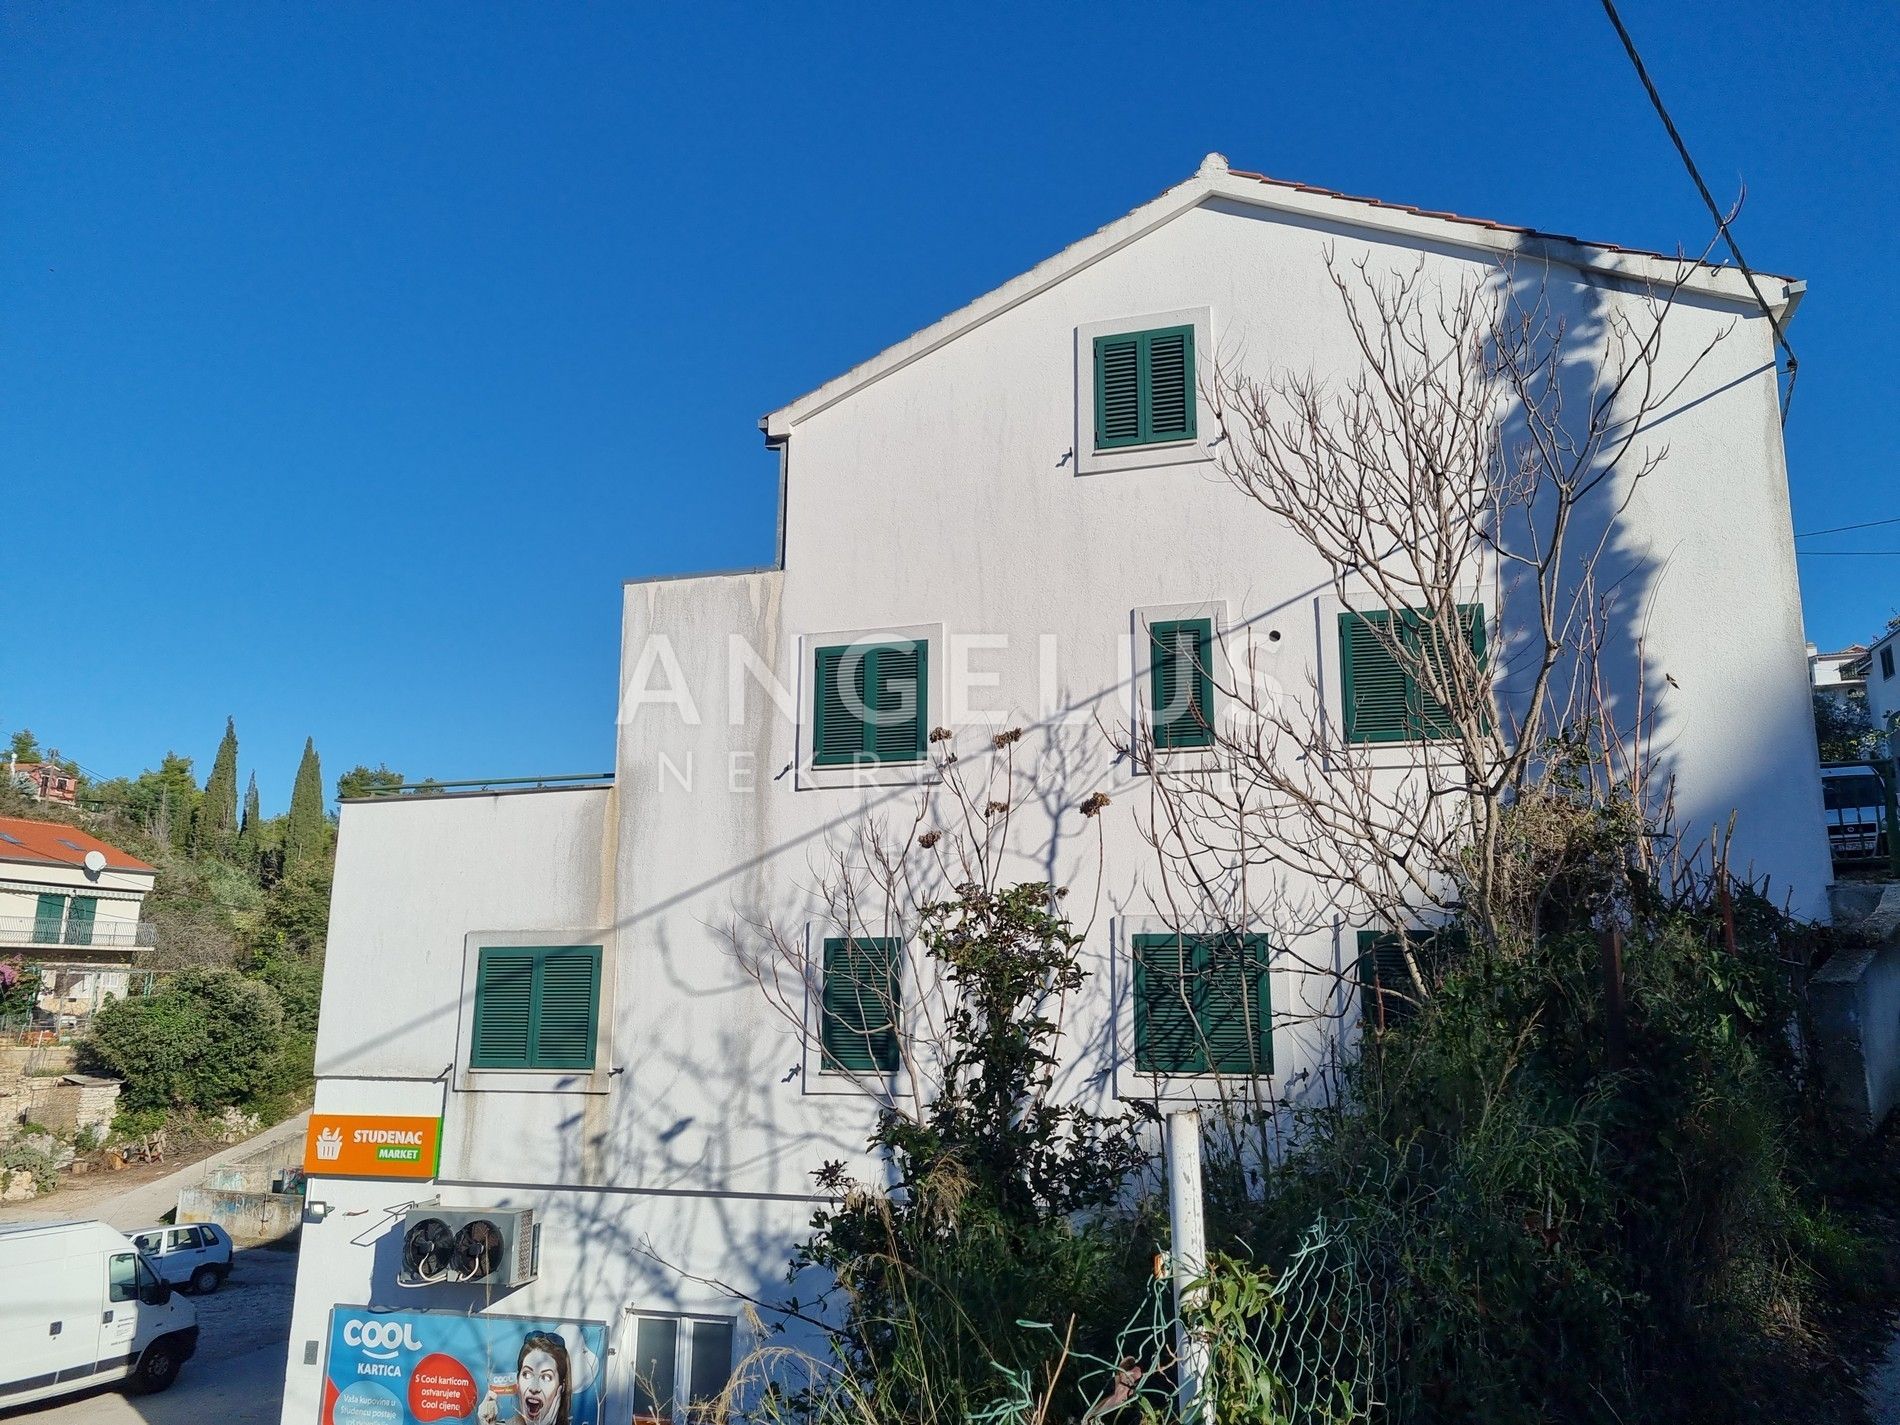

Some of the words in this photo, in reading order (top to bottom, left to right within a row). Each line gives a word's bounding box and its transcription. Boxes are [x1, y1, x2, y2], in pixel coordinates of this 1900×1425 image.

[353, 1129, 423, 1145] STUDENAC
[378, 1149, 418, 1160] MARKET
[343, 1319, 423, 1352] COOL
[357, 1362, 402, 1377] KARTICA
[415, 1374, 420, 1383] S
[420, 1374, 438, 1382] Cool
[438, 1376, 469, 1387] karticom
[421, 1388, 461, 1400] ostvarujete
[421, 1399, 438, 1410] Cool
